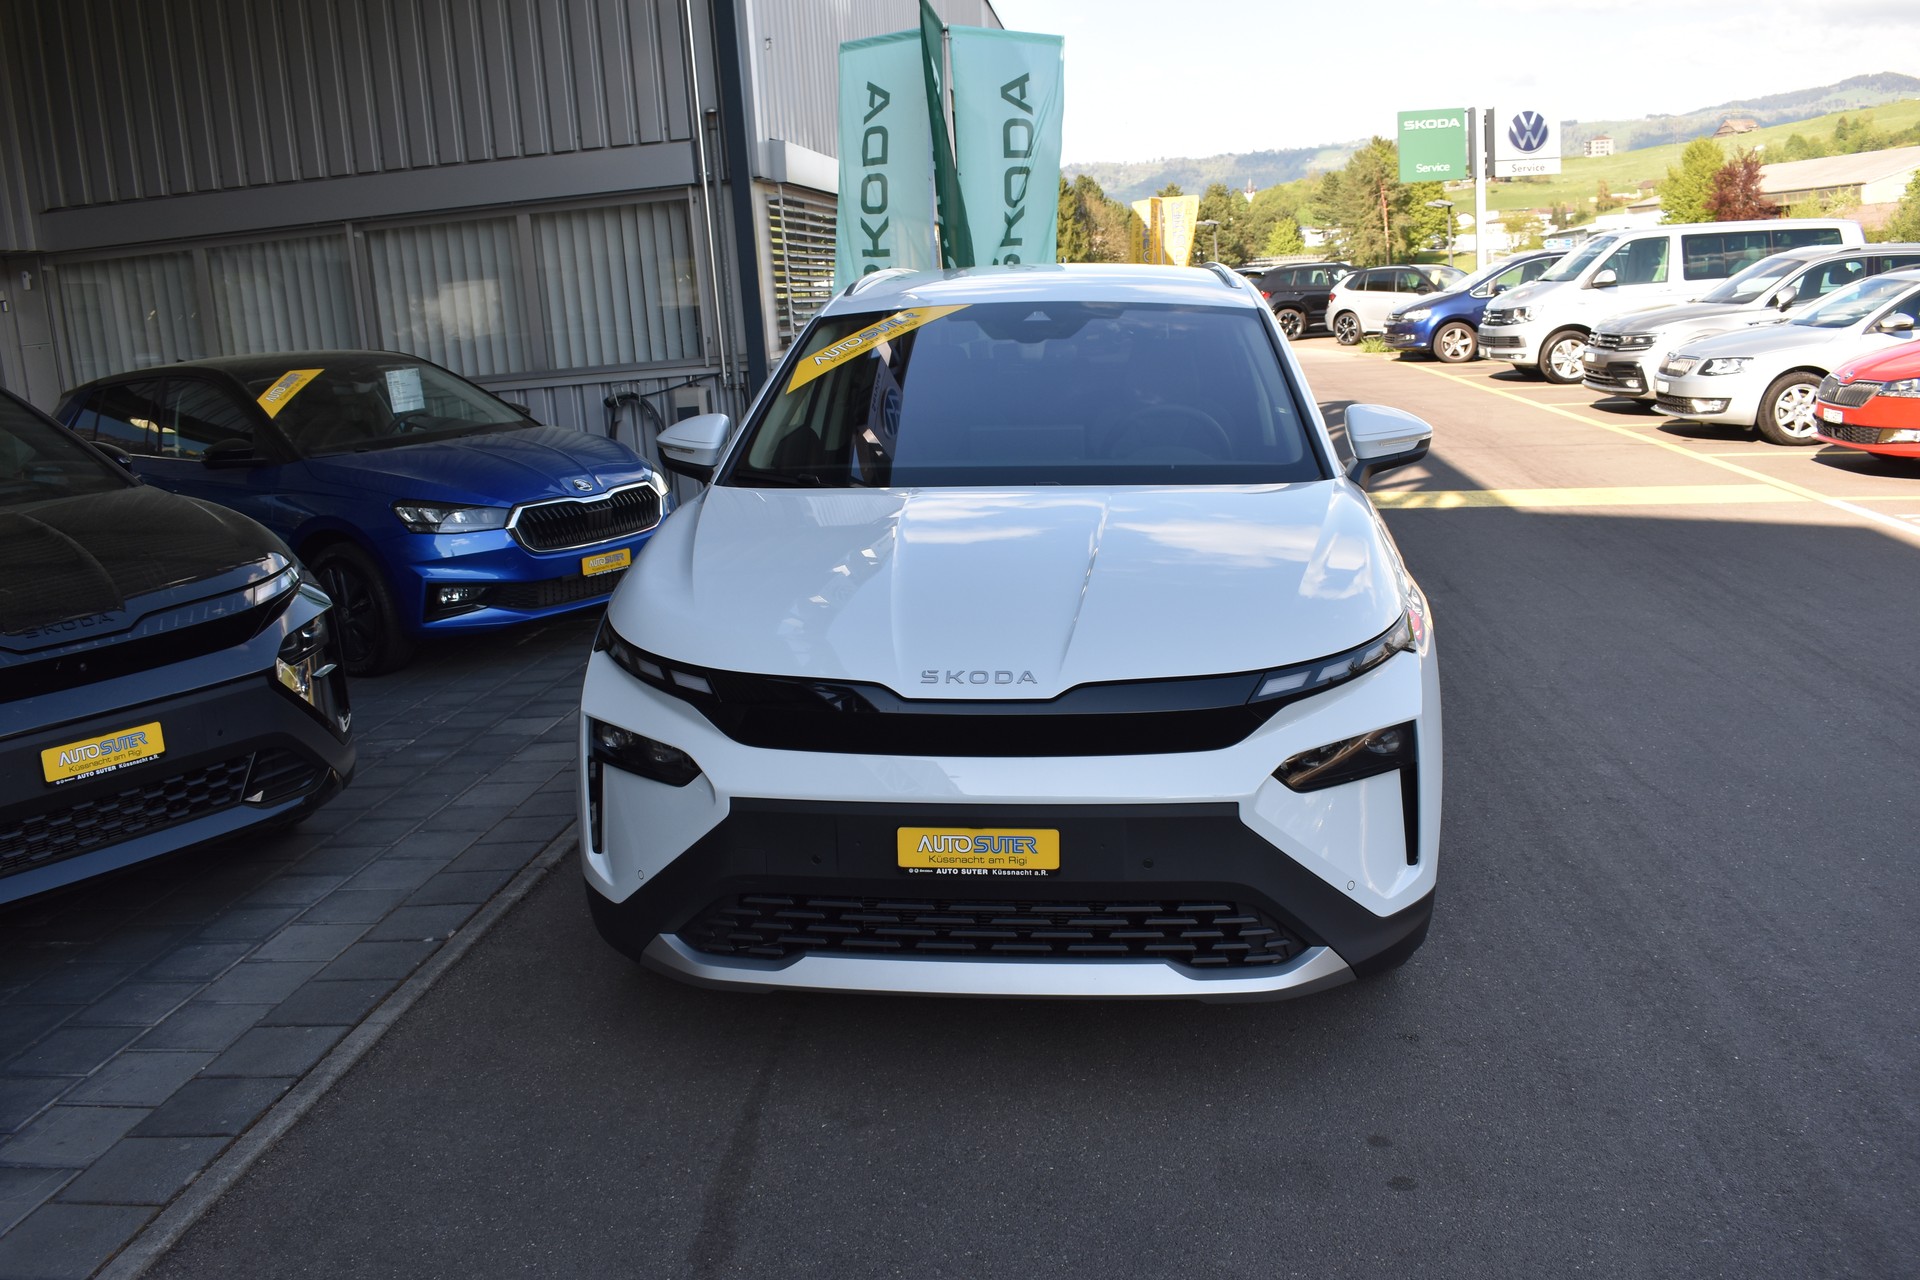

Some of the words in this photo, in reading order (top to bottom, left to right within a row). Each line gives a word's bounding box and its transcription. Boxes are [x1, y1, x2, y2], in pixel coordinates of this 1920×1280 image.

[1403, 118, 1460, 131] SKODA
[1415, 162, 1451, 174] Service
[1511, 164, 1546, 173] Service
[920, 670, 1038, 684] SKODA
[68, 757, 112, 773] Küssnacht
[113, 753, 127, 761] am
[128, 748, 143, 758] Rigi
[77, 771, 95, 780] AUTO
[95, 765, 117, 775] SUTER
[928, 855, 985, 864] Küssnacht
[1008, 856, 1028, 866] Rigi
[992, 868, 1032, 876] Küssnacht
